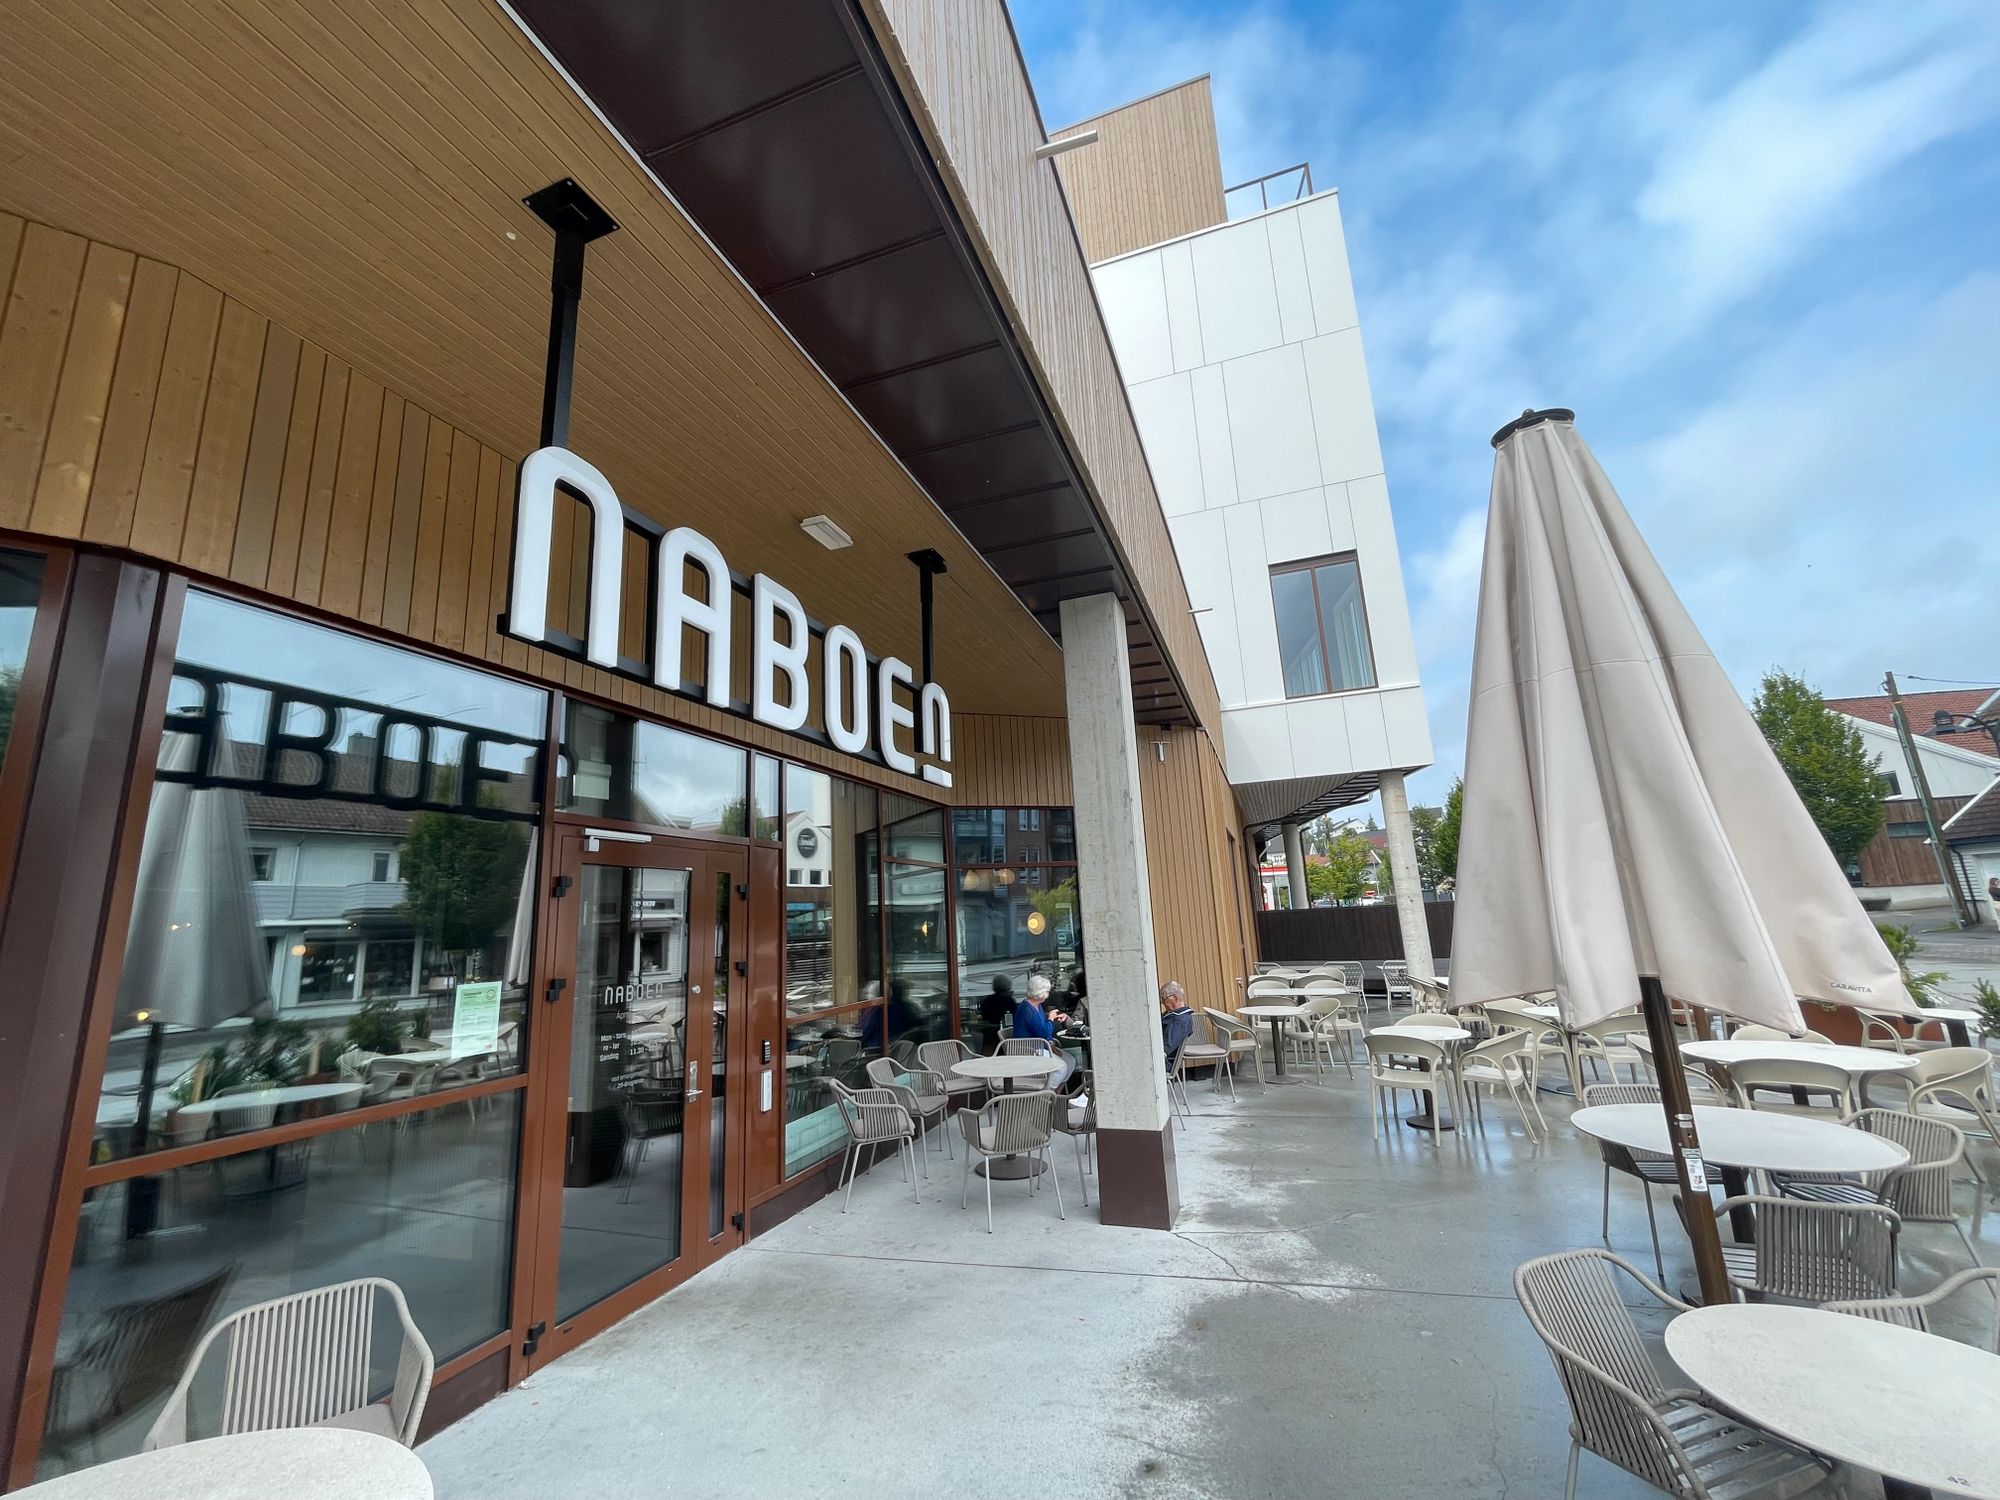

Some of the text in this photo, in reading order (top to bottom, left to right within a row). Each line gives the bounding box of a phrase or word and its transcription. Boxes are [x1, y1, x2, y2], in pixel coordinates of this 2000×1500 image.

[509, 446, 952, 788] NABOEN
[604, 982, 663, 1005] NABOEN
[1829, 981, 1873, 993] CARAVITA
